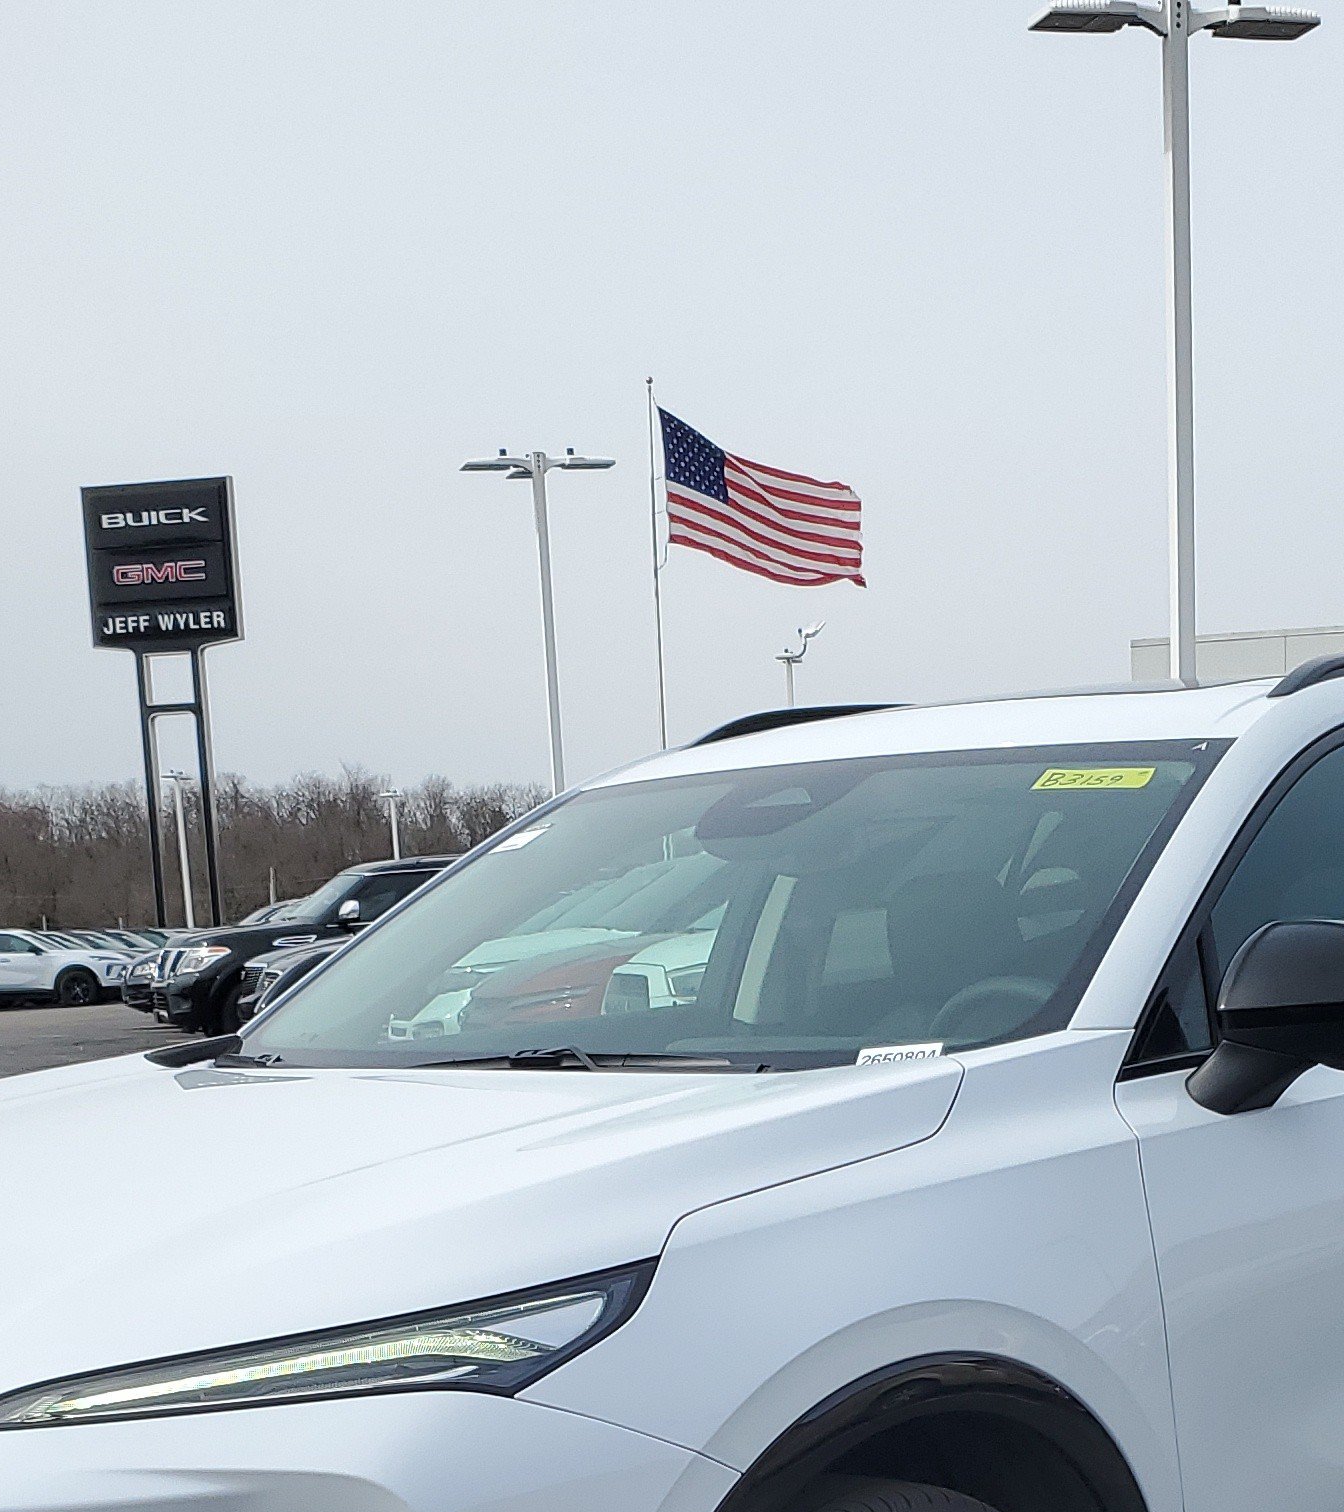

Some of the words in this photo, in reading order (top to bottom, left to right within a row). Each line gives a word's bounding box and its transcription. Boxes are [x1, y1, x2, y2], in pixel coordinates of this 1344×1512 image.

[99, 507, 209, 529] BUICK
[113, 560, 206, 586] GMC
[102, 614, 150, 635] JEFF
[158, 610, 226, 632] WYLER
[1040, 771, 1124, 788] B3159
